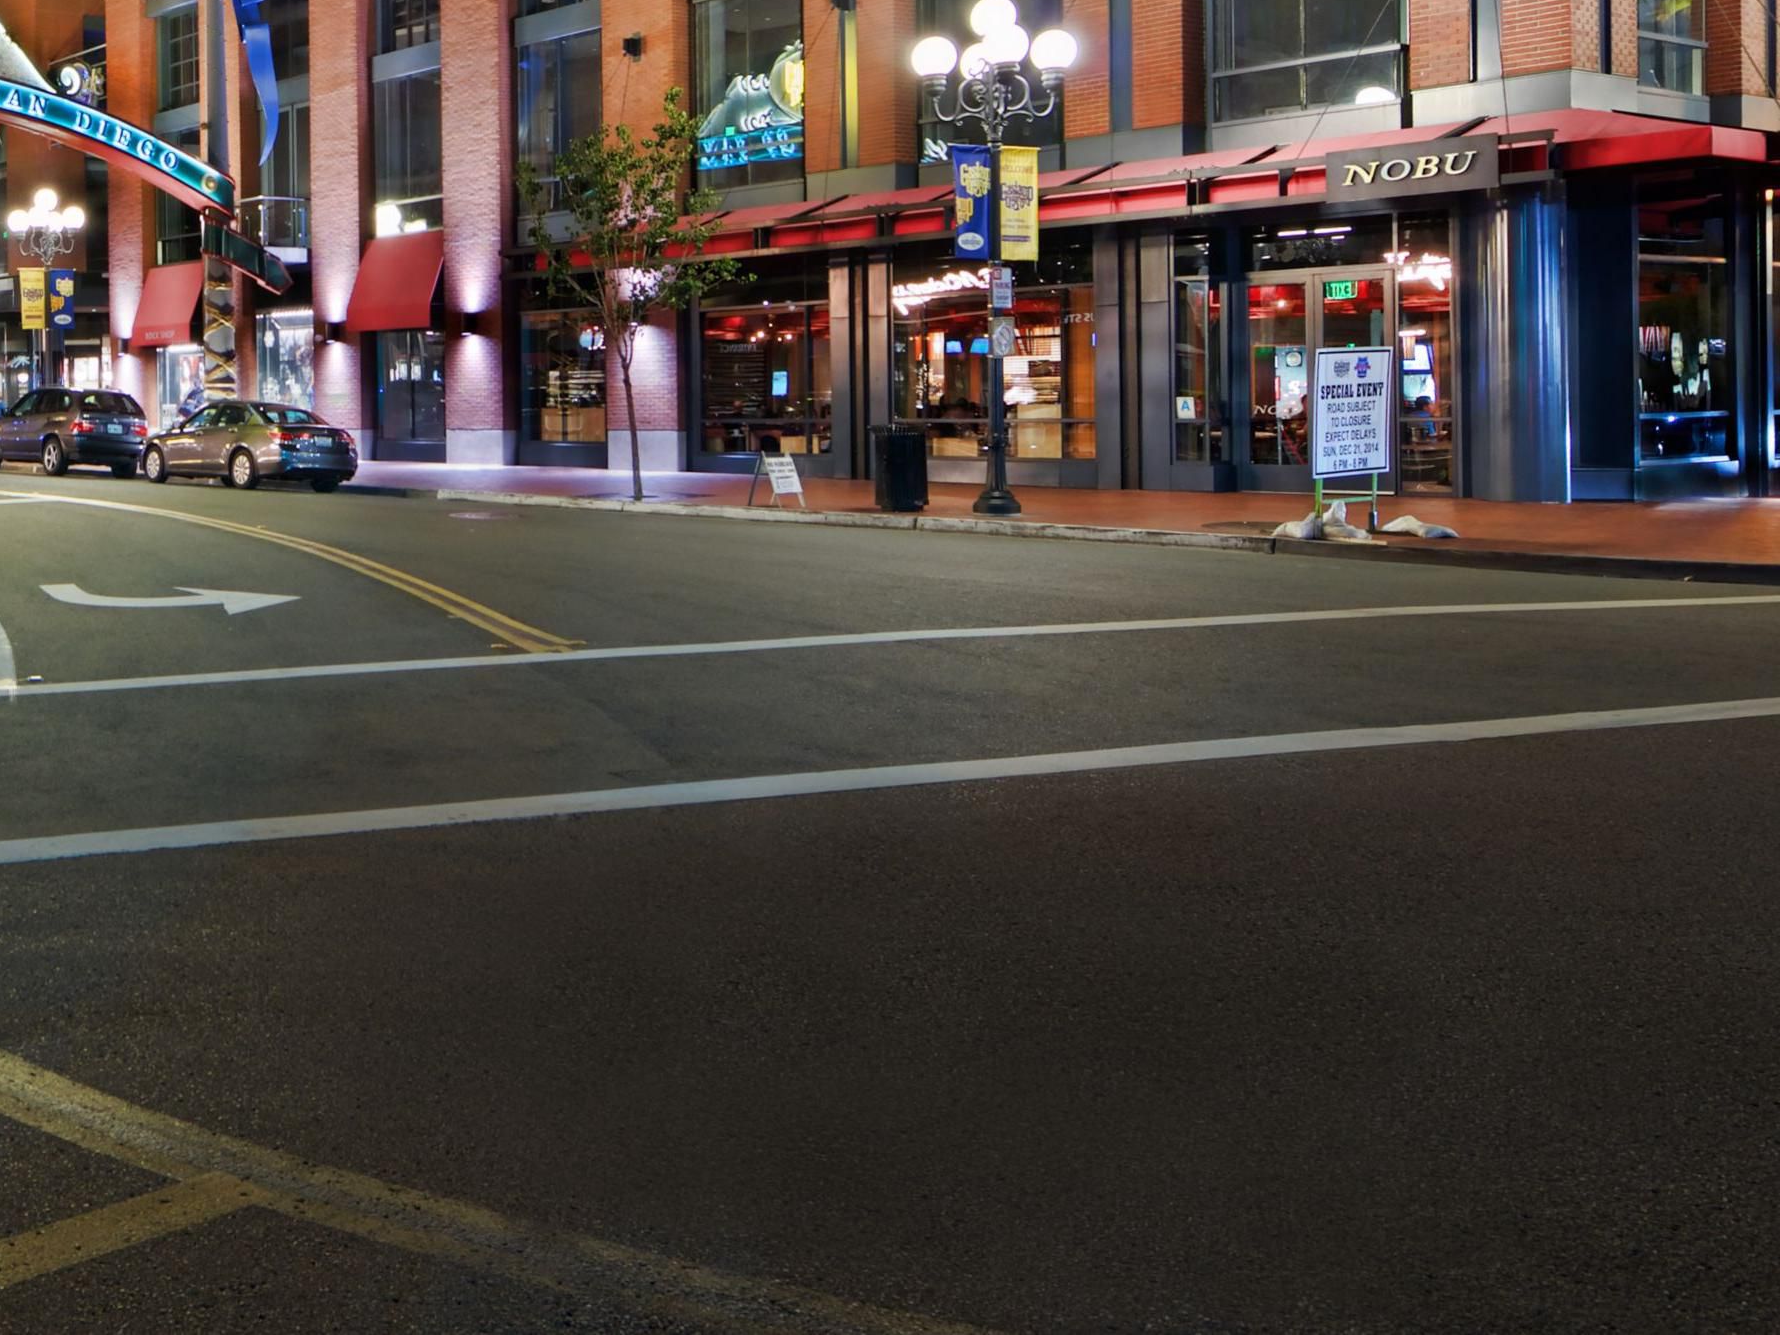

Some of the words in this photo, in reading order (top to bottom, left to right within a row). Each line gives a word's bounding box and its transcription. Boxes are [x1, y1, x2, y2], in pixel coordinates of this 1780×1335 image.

[75, 111, 179, 171] DIEGO
[1342, 150, 1477, 186] NOBU
[1321, 385, 1354, 400] SPECIAL
[1357, 382, 1384, 397] EVENT
[1327, 403, 1345, 413] ROAD
[1347, 401, 1376, 411] SUBJECT
[1331, 417, 1339, 427] TO
[1341, 415, 1372, 426] CLOSURE
[1325, 430, 1349, 442] EXPECT
[1351, 428, 1376, 440] DELAYS
[1339, 445, 1352, 455] DEC
[1364, 443, 1379, 453] 2014
[1338, 459, 1348, 469] PM
[1358, 457, 1368, 467] PM
